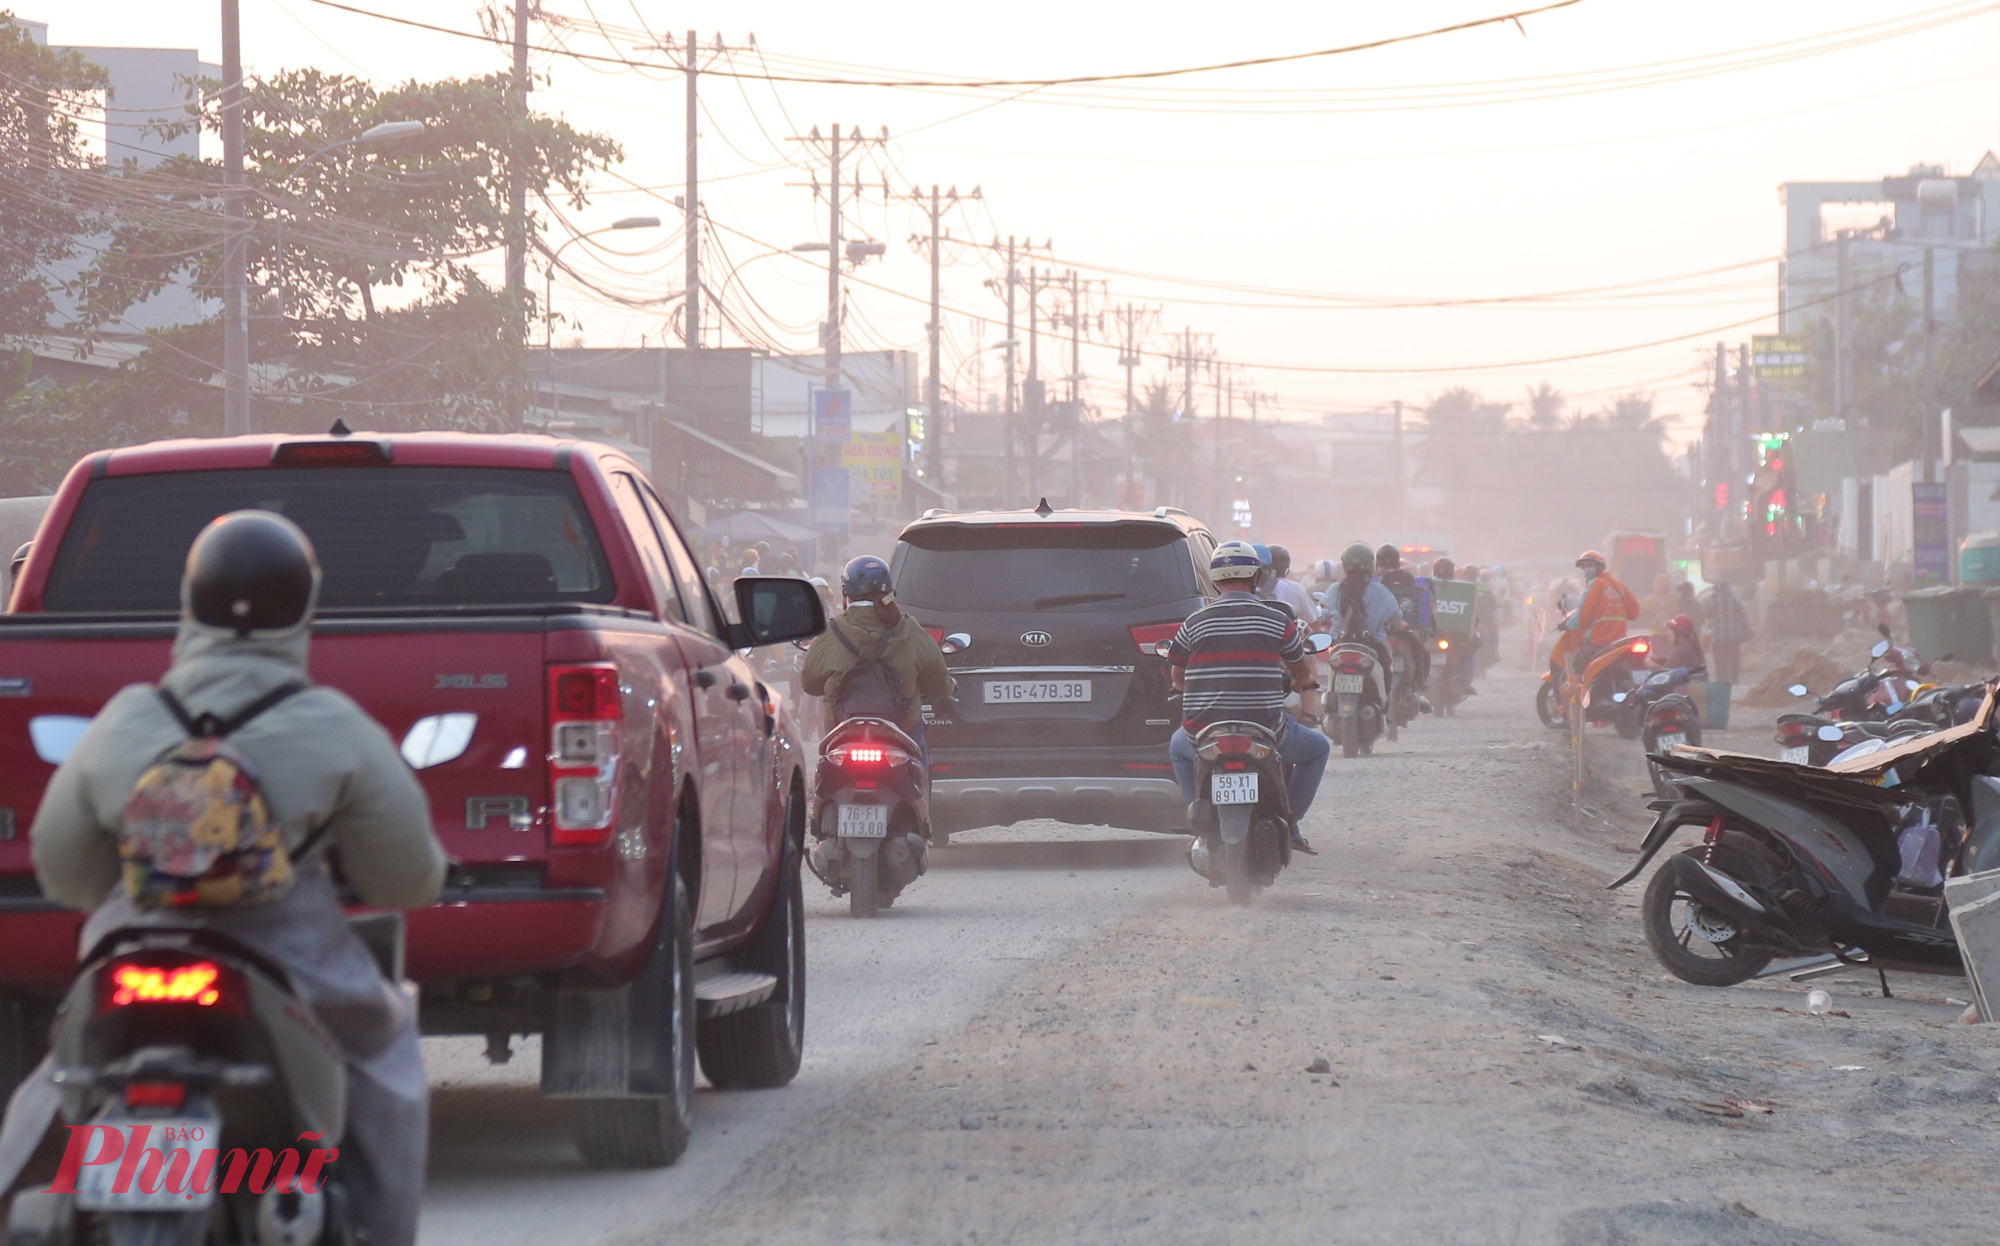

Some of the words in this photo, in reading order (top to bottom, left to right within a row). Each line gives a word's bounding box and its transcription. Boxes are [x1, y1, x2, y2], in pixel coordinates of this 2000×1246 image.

[843, 444, 865, 457] GIA
[1025, 634, 1047, 644] KIA
[992, 683, 1083, 699] 51G-478.38
[1219, 775, 1250, 789] 59-X1
[1215, 788, 1256, 803] 891.10
[846, 807, 879, 820] 76-F1
[842, 822, 884, 836] 113.88
